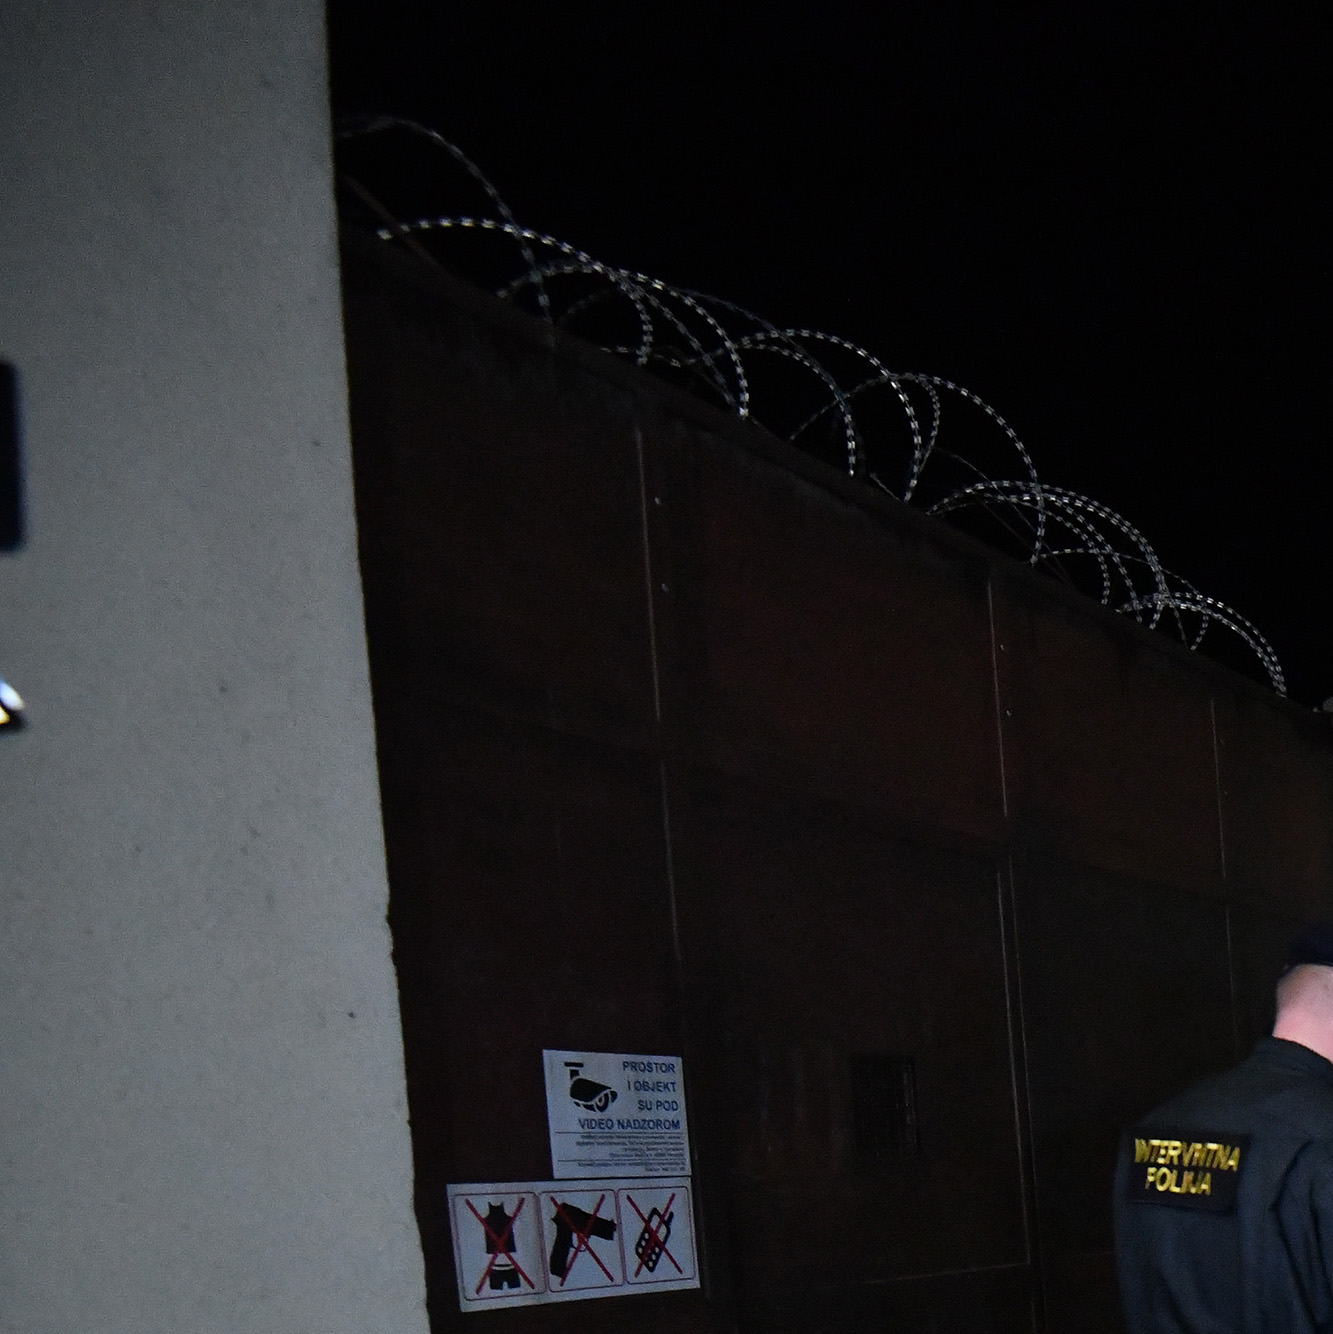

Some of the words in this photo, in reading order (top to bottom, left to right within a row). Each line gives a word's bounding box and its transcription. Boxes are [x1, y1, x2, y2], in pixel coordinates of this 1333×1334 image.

[623, 1061, 675, 1073] PROSTOR
[634, 1081, 676, 1092] OBJEKT
[637, 1100, 653, 1111] SU
[656, 1100, 679, 1111] POD
[579, 1118, 614, 1130] VIDEO
[617, 1119, 680, 1130] NADZOROM
